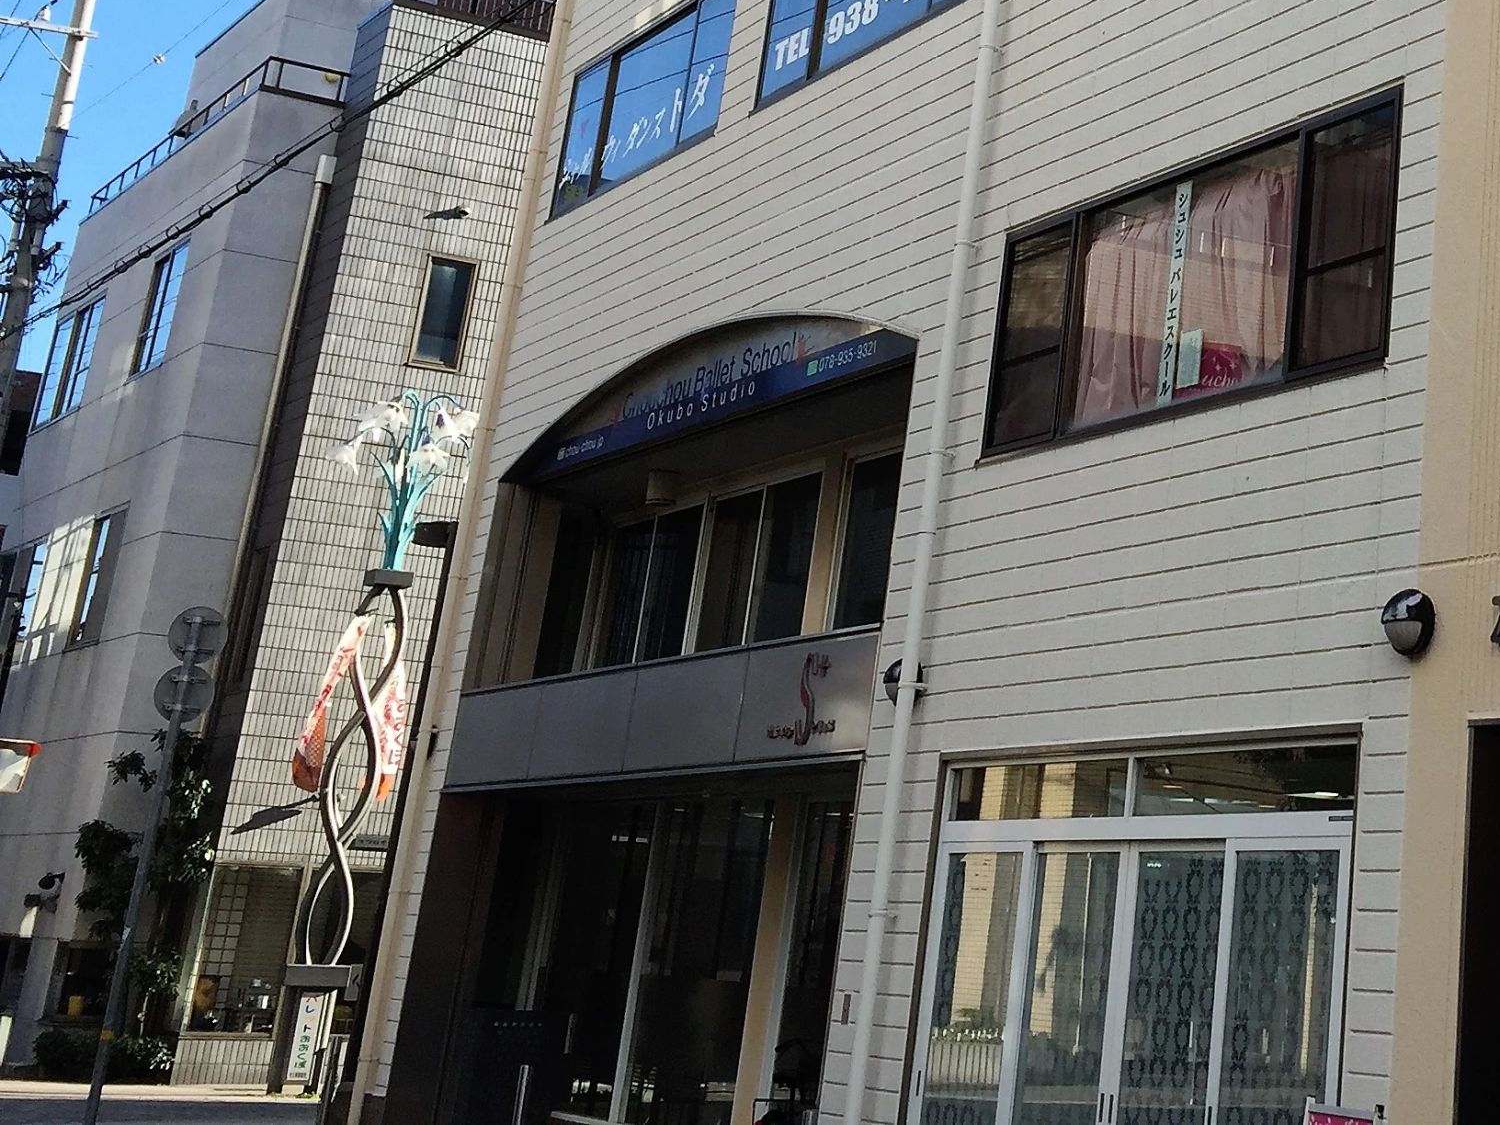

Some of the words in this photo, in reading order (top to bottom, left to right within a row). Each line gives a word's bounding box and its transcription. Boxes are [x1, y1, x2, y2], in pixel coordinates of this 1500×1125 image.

[775, 27, 811, 72] TEL
[694, 356, 736, 393] Ballet
[740, 330, 800, 375] School
[646, 403, 694, 432] Okubo
[701, 379, 757, 413] Studio
